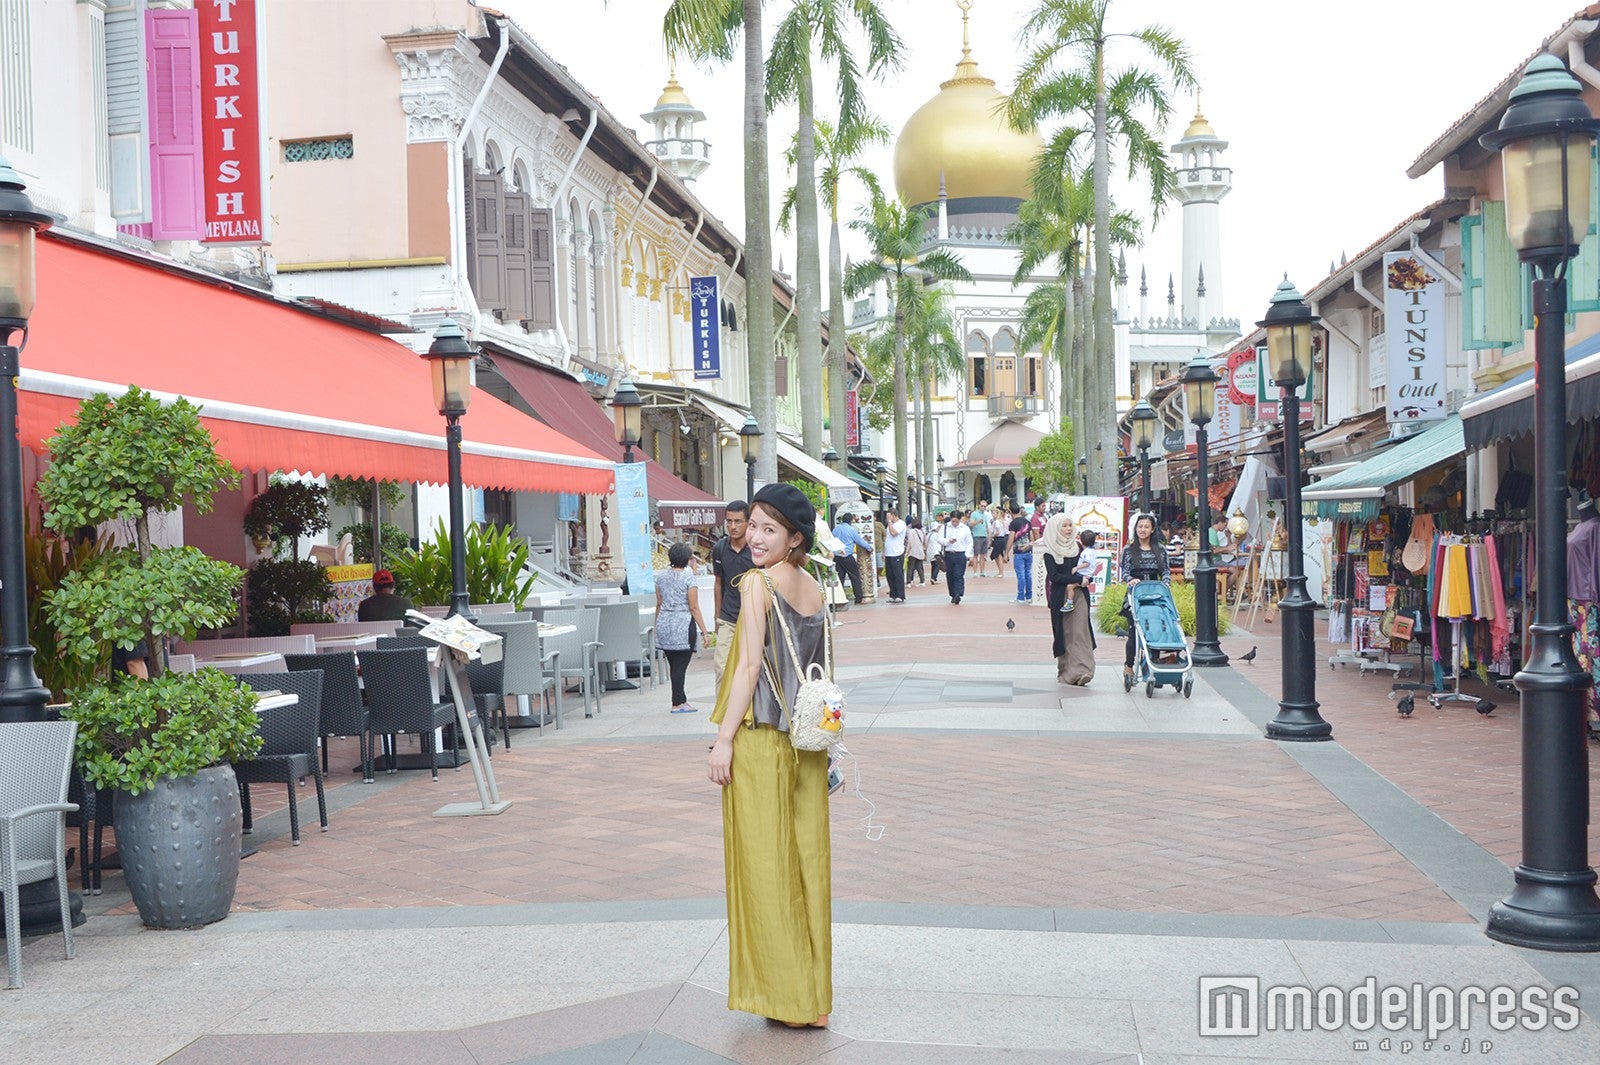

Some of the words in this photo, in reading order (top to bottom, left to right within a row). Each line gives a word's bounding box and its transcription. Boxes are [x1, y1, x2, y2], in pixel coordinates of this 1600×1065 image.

[212, 0, 244, 215] TURKISH
[700, 298, 711, 369] TURKISH
[1404, 291, 1428, 380] TUNSI
[1398, 382, 1438, 398] Oud
